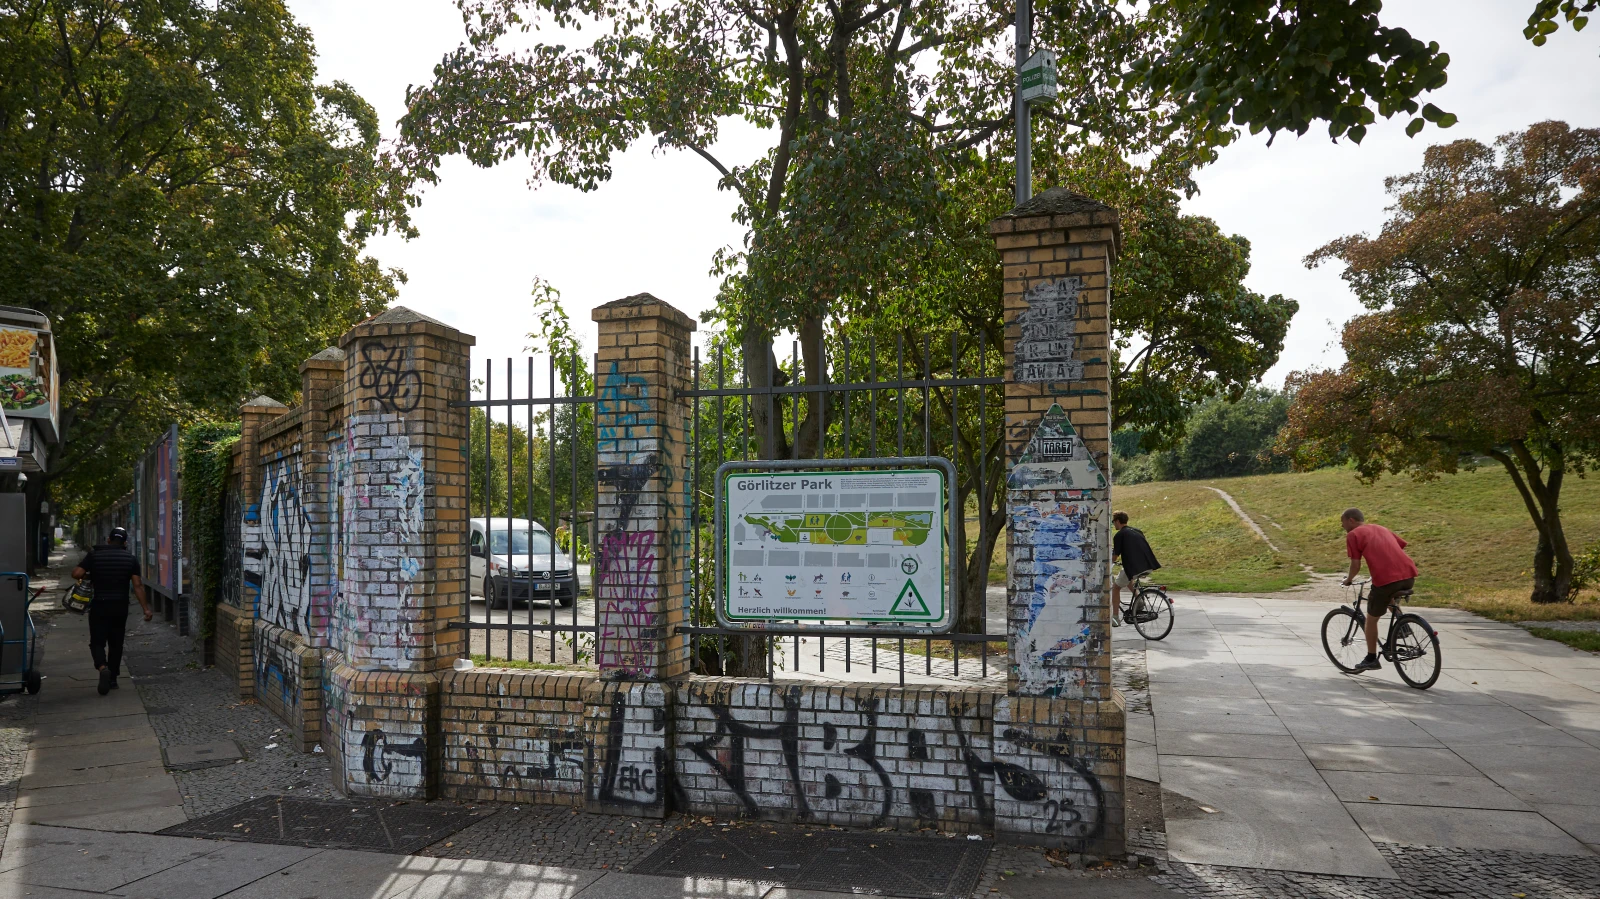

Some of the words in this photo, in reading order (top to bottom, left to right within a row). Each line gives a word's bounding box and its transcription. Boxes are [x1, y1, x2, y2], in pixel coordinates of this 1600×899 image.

[737, 479, 796, 491] Görlitzer
[801, 478, 832, 490] Park
[737, 606, 771, 614] Herzlich
[773, 607, 826, 615] willkommen!
